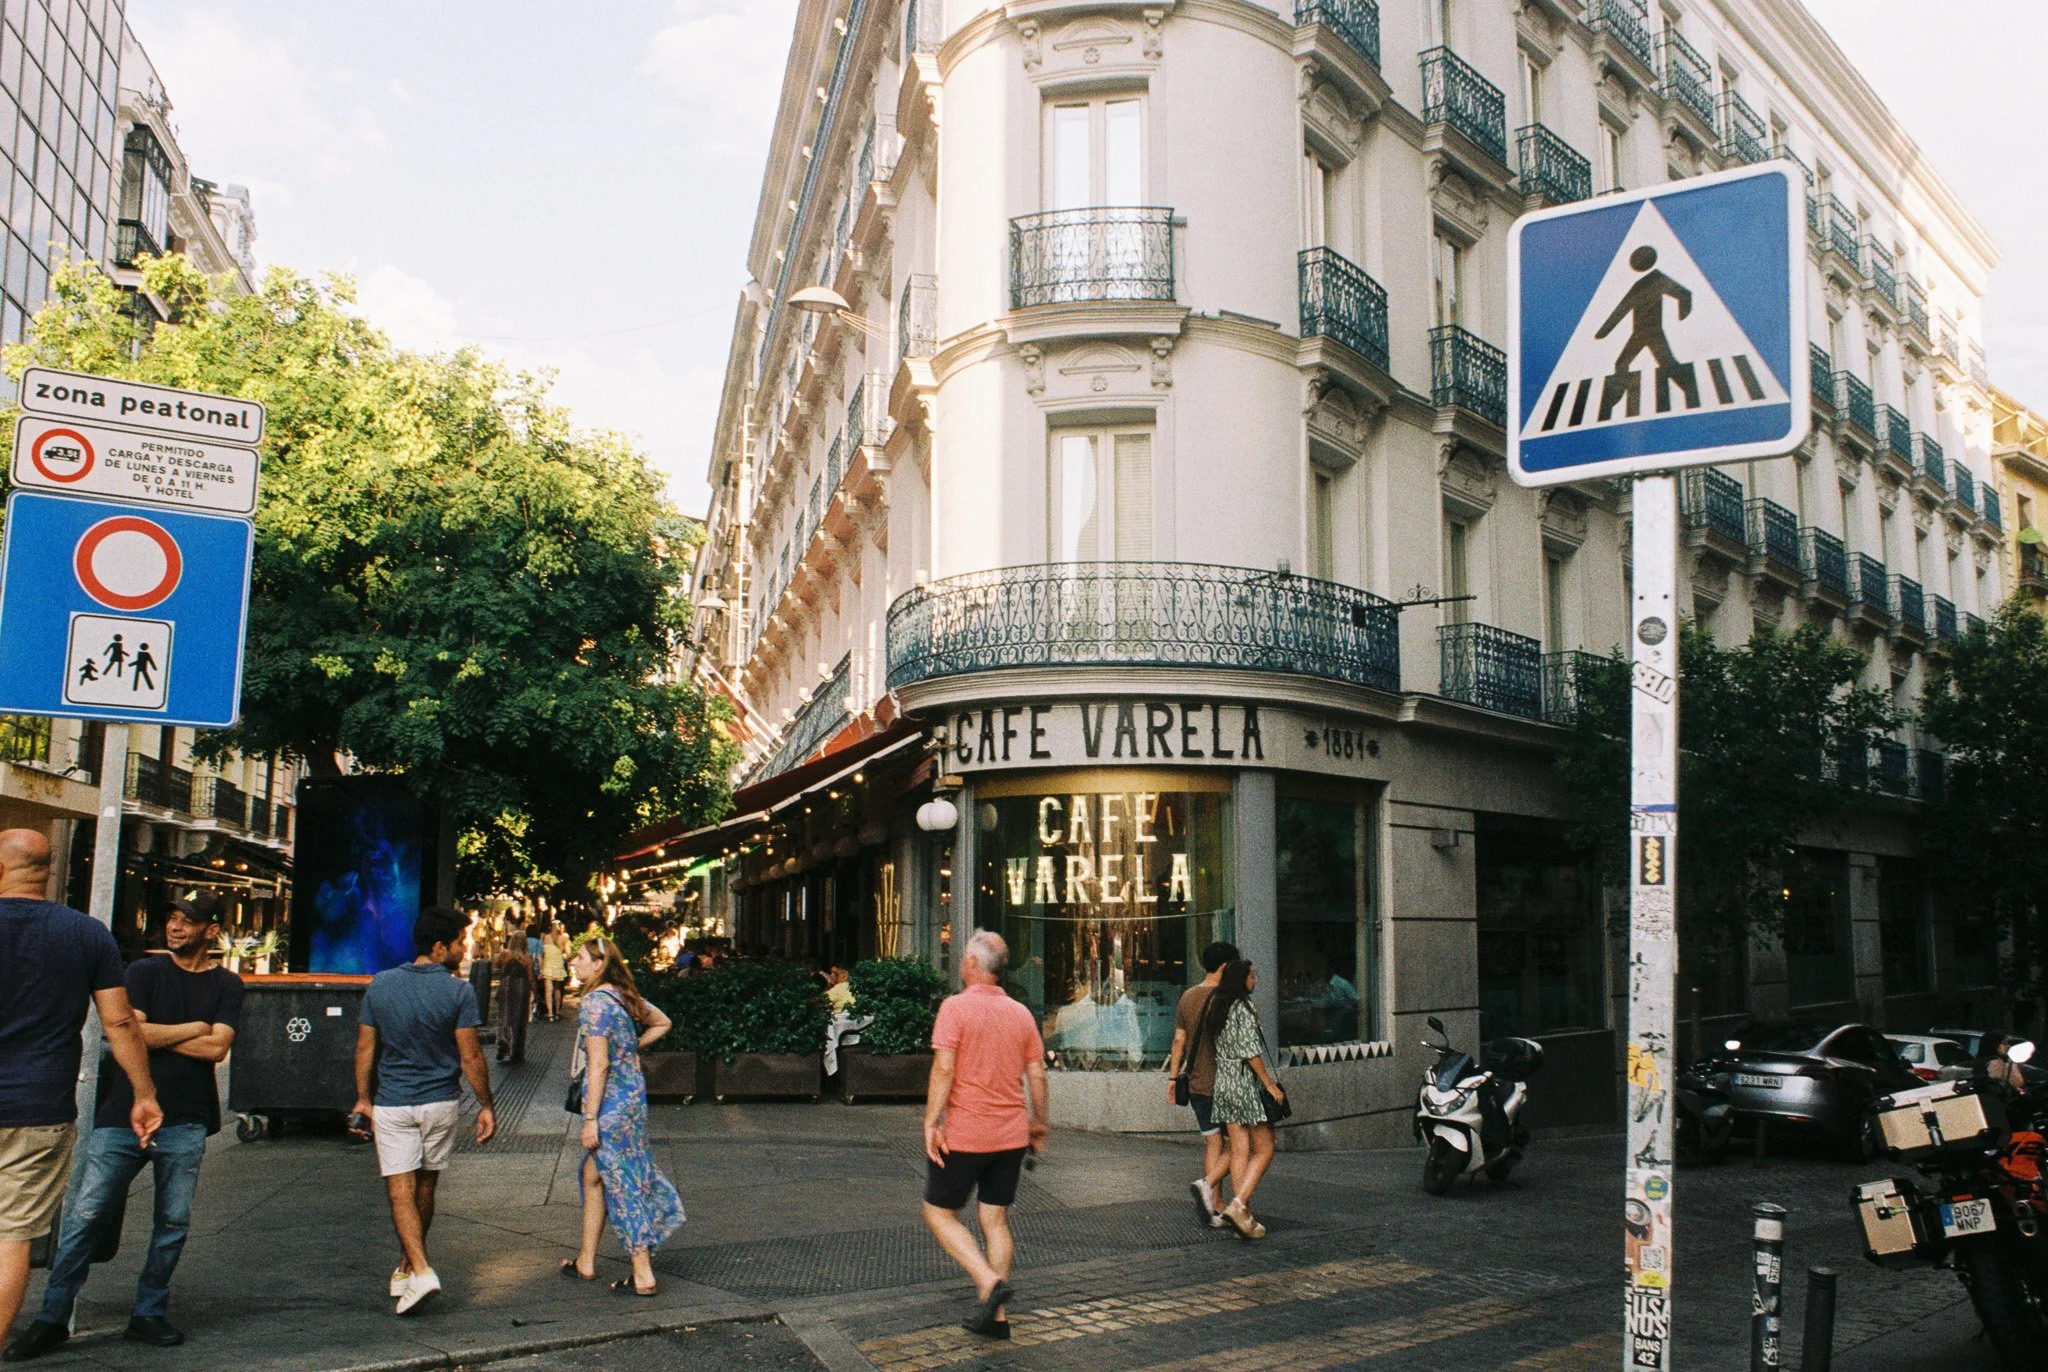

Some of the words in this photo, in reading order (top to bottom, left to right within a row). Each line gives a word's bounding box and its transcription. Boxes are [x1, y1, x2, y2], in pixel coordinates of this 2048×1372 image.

[36, 383, 105, 407] zona
[120, 396, 249, 429] peatonal
[109, 448, 151, 461] CARGA
[156, 455, 163, 463] Y
[168, 457, 233, 473] DESCARGA
[141, 442, 204, 458] PERMITIDO
[105, 458, 121, 468] DE
[126, 461, 166, 474] LUNES
[172, 468, 180, 476] A
[185, 469, 235, 484] VIERNES
[132, 473, 149, 483] DE
[168, 478, 176, 486] A
[181, 480, 190, 489] 11
[144, 485, 151, 493] Y
[156, 487, 194, 499] HOTEL
[955, 704, 1052, 764] CAFE
[1080, 702, 1265, 760] VARELA
[1037, 792, 1159, 848] CAFE
[1006, 853, 1193, 905] VARELA
[1953, 1203, 1986, 1219] 9067
[1956, 1217, 1982, 1231] MNP
